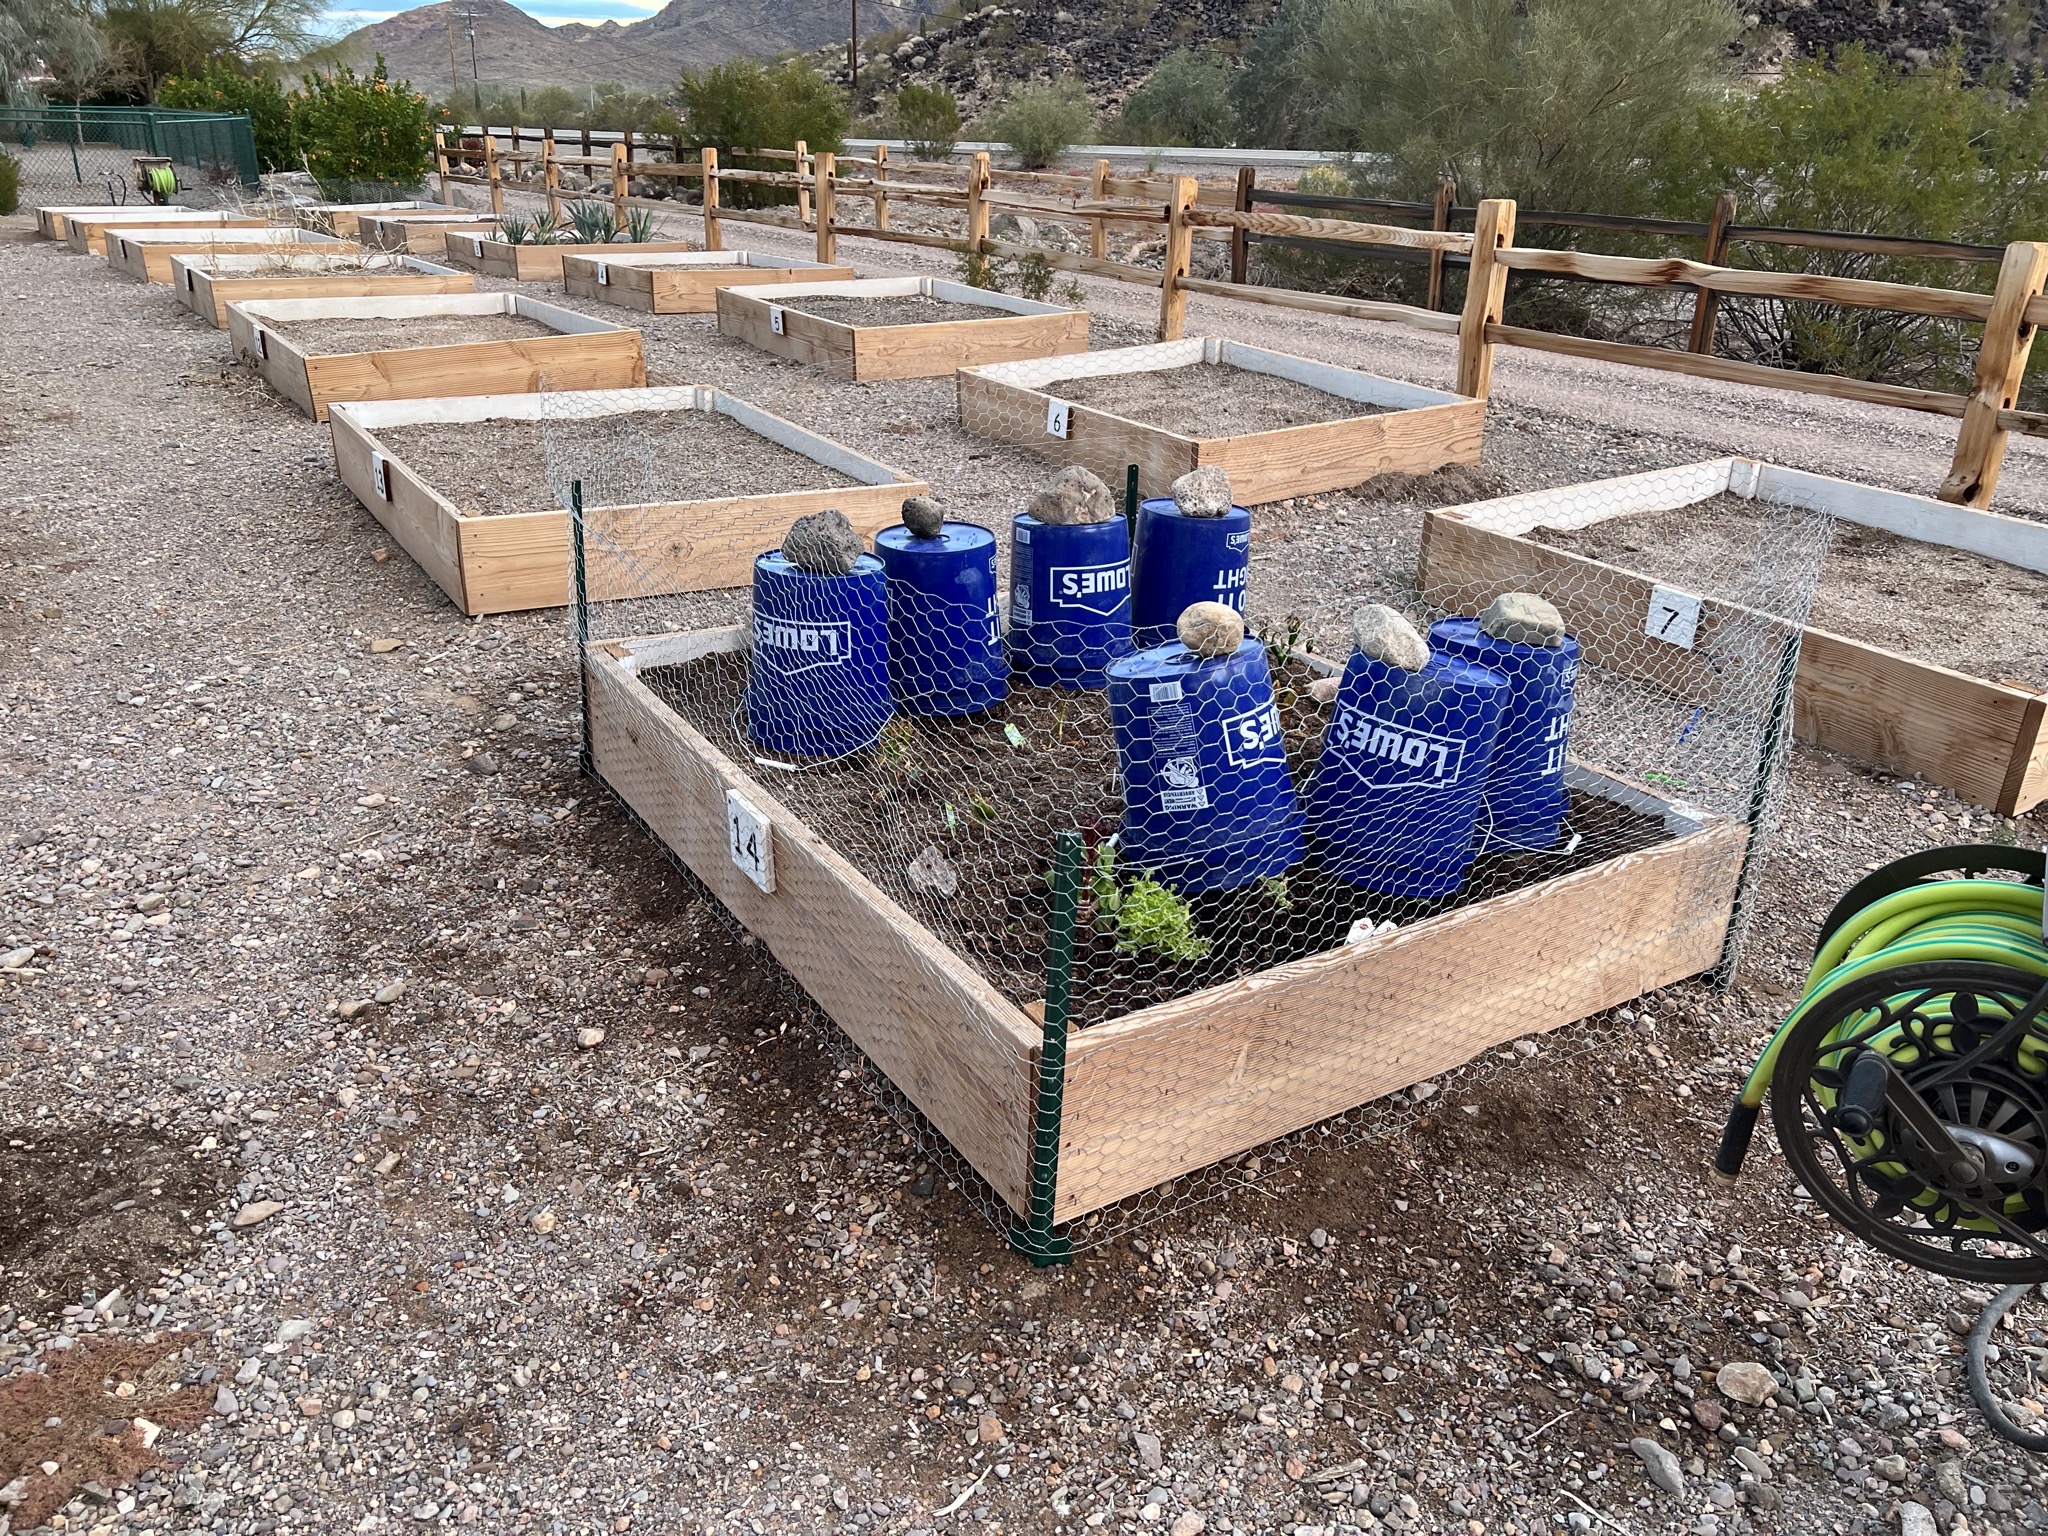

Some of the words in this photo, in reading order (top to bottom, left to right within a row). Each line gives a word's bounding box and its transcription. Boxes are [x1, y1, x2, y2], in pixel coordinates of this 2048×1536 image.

[774, 316, 780, 331] 5
[1053, 413, 1061, 433] 6
[375, 467, 384, 494] 13
[1062, 565, 1130, 598] LOWE'S
[1213, 566, 1247, 590] GHT
[1660, 606, 1679, 635] 7
[1336, 711, 1449, 778] LOWE'S
[733, 816, 760, 872] 14
